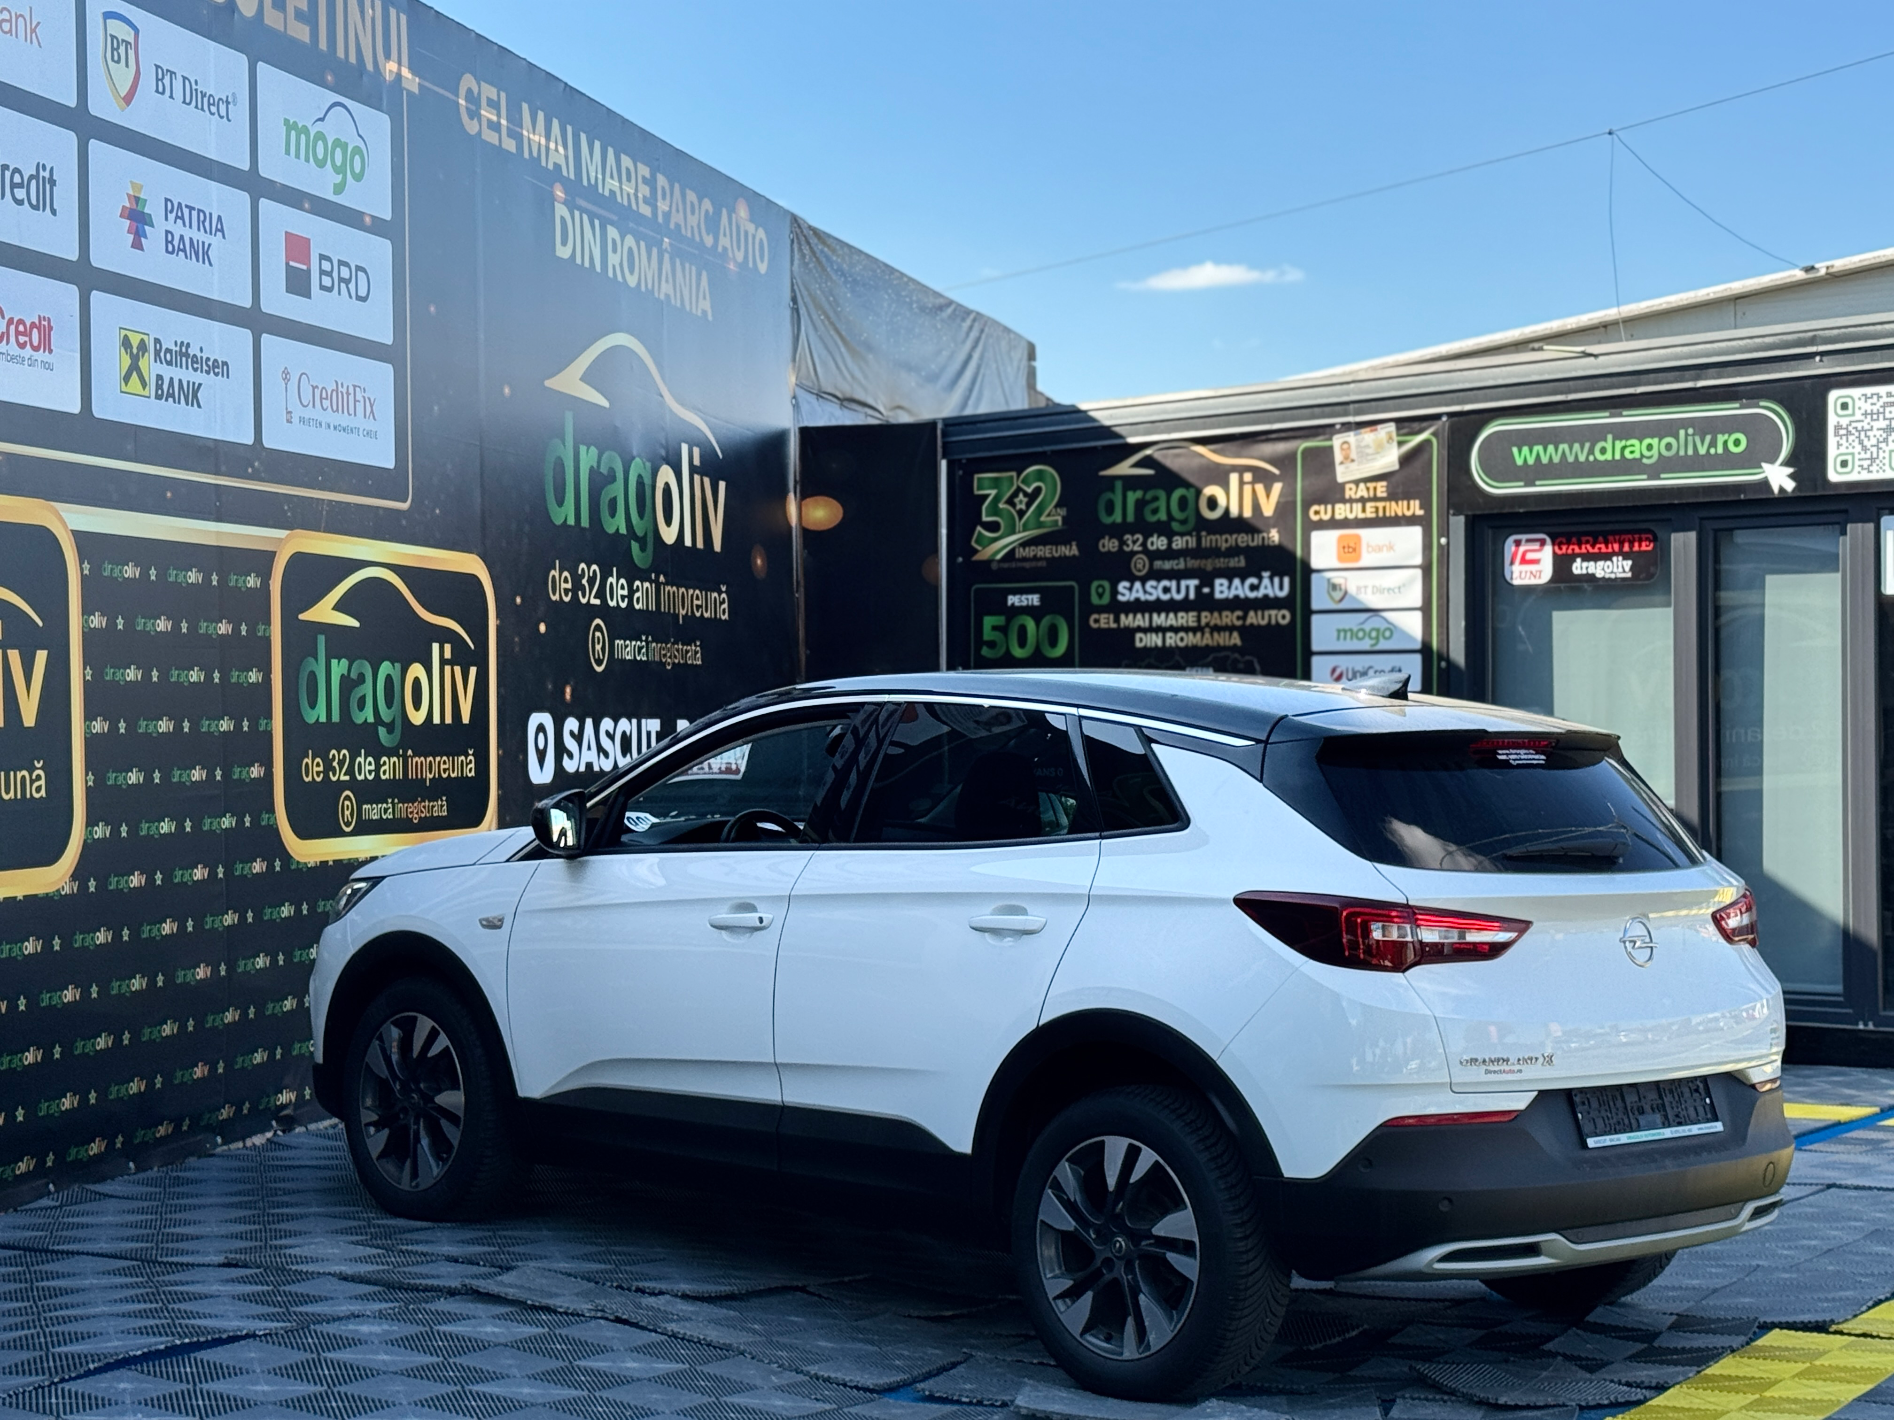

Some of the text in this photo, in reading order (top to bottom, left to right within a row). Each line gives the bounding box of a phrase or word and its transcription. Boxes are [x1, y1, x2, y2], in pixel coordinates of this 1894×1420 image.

[0, 6, 42, 48] ank
[109, 34, 132, 69] BT
[154, 63, 177, 101] BT
[283, 117, 366, 196] mogo
[458, 73, 768, 275] CEL MAI MARE PARC AUTO
[0, 161, 57, 217] redit
[163, 197, 227, 240] PATRIA
[164, 228, 214, 268] BANK
[554, 200, 712, 321] DIN ROMÂNIA
[318, 253, 371, 303] BRD
[153, 338, 230, 380] Raiffeisen
[154, 374, 203, 409] BANK
[297, 372, 377, 421] CreditFix
[1511, 427, 1748, 467] www.dragoliv.ro
[543, 410, 727, 570] dragoliv
[1097, 472, 1284, 532] dragoliv
[1345, 482, 1388, 499] RATE
[970, 465, 1061, 551] 32
[1309, 500, 1425, 521] CU BULETINUL
[1099, 528, 1280, 552] de 32 de ani împreună
[1342, 543, 1358, 555] tbi
[1366, 541, 1396, 554] bank
[1510, 538, 1547, 566] 12
[1554, 534, 1654, 555] GARANTIE
[102, 561, 261, 591] dragoliv dragoliv dragoliv
[1510, 570, 1543, 581] LUNI
[1572, 556, 1632, 578] dragoliv
[548, 560, 729, 624] de 32 de ani împreună
[1007, 594, 1041, 606] PESTE
[1117, 579, 1199, 602] SASCUT
[1214, 571, 1290, 600] BACĂU
[1356, 585, 1369, 596] BT
[135, 616, 172, 635] dragoliv
[198, 619, 233, 637] dragoliv
[1089, 609, 1291, 628] CEL MAI MARE PARC AUTO
[614, 636, 647, 661] marcă
[980, 614, 1069, 659] 500
[1135, 628, 1242, 648] DIN ROMÂNIA
[1336, 625, 1394, 648] mogo
[104, 665, 263, 686] dragoliv dragoliv dragoliv
[299, 634, 477, 747] dragoliv
[137, 717, 174, 736] dragoliv
[200, 716, 235, 736] dragoliv
[106, 763, 265, 788] dragoliv dragoliv dragoliv
[302, 749, 475, 786] de 32 de ani împreună
[139, 817, 176, 838] dragoliv
[202, 813, 236, 832] dragoliv
[362, 798, 393, 820] marcă
[394, 796, 448, 823] înregistrată
[107, 870, 146, 892] dragoliv
[172, 864, 209, 885] dragoliv
[233, 858, 267, 877] dragoliv
[0, 937, 43, 959] dragoliv
[72, 927, 113, 949] dragoliv
[140, 918, 178, 939] dragoliv
[204, 910, 239, 930] dragoliv
[262, 902, 295, 922] dragoliv
[39, 985, 81, 1007] dragoliv
[110, 974, 147, 996] dragoliv
[175, 963, 211, 985] dragoliv
[236, 954, 270, 974] dragoliv
[0, 996, 297, 1070] dragoliv dragoliv dragoliv dragoliv dragoliv
[37, 1093, 79, 1117] dragoliv
[108, 1077, 146, 1100] dragoliv
[173, 1063, 209, 1084] dragoliv
[234, 1049, 268, 1069] dragoliv
